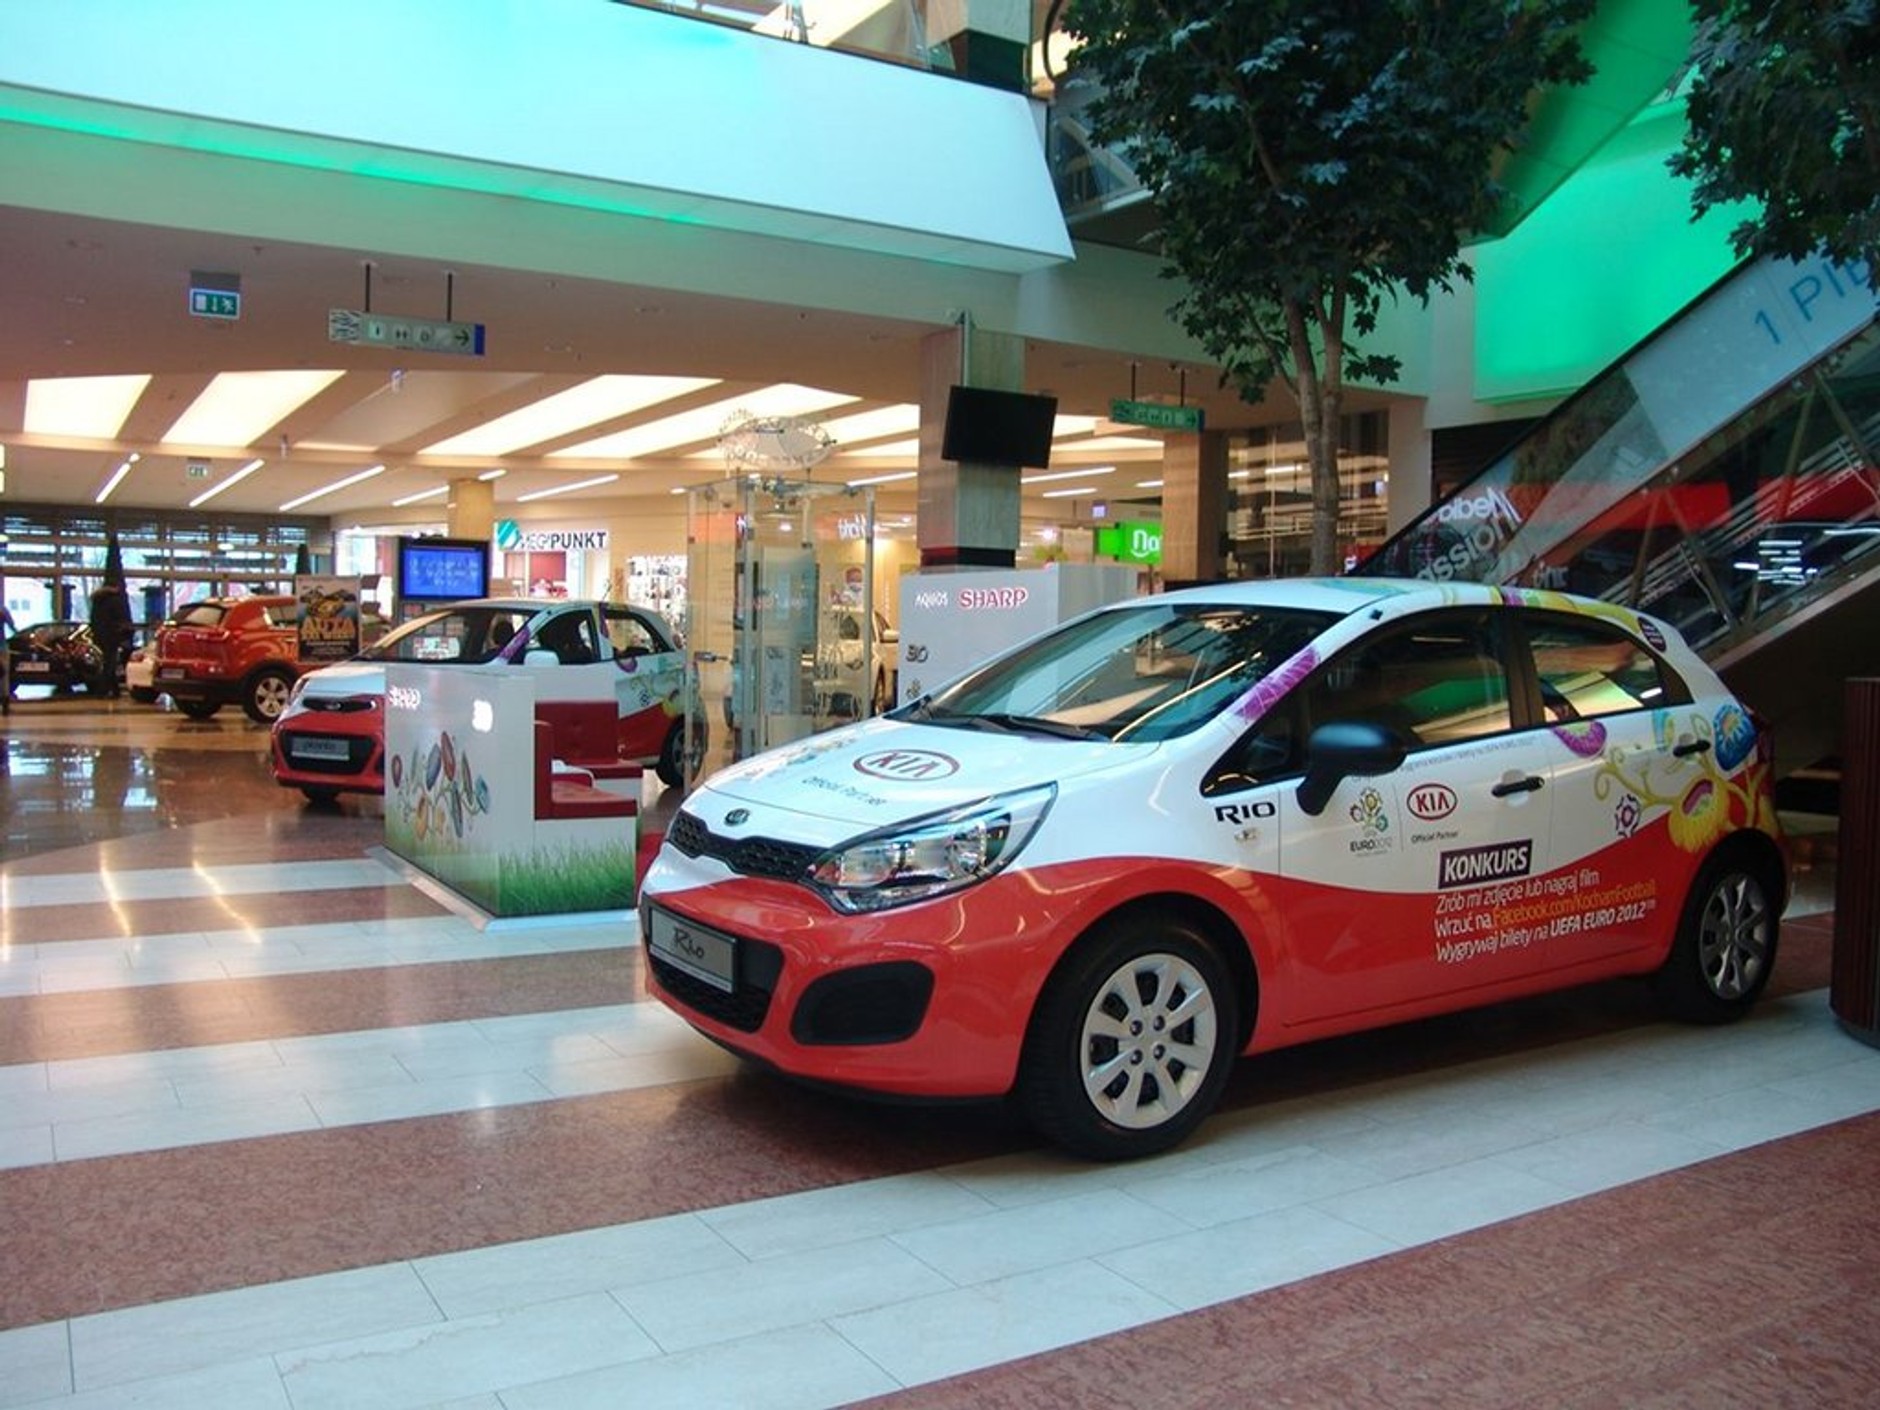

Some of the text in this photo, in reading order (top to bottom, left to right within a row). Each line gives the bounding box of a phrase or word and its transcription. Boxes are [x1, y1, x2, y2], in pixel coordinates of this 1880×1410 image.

[1755, 309, 1781, 344] 1
[958, 587, 1029, 609] SHARP
[867, 752, 941, 778] KIA
[1215, 801, 1276, 824] RIO
[1415, 791, 1450, 812] KIA
[1445, 846, 1528, 882] KONKURS
[1525, 879, 1543, 895] lub
[1544, 870, 1578, 896] nagraj
[1579, 868, 1600, 887] film
[674, 926, 704, 958] Rio
[1436, 938, 1499, 963] Wygrywaj
[1500, 924, 1533, 949] bilety
[1534, 925, 1550, 940] na
[1550, 913, 1581, 937] UEFA
[1583, 904, 1616, 930] EURO
